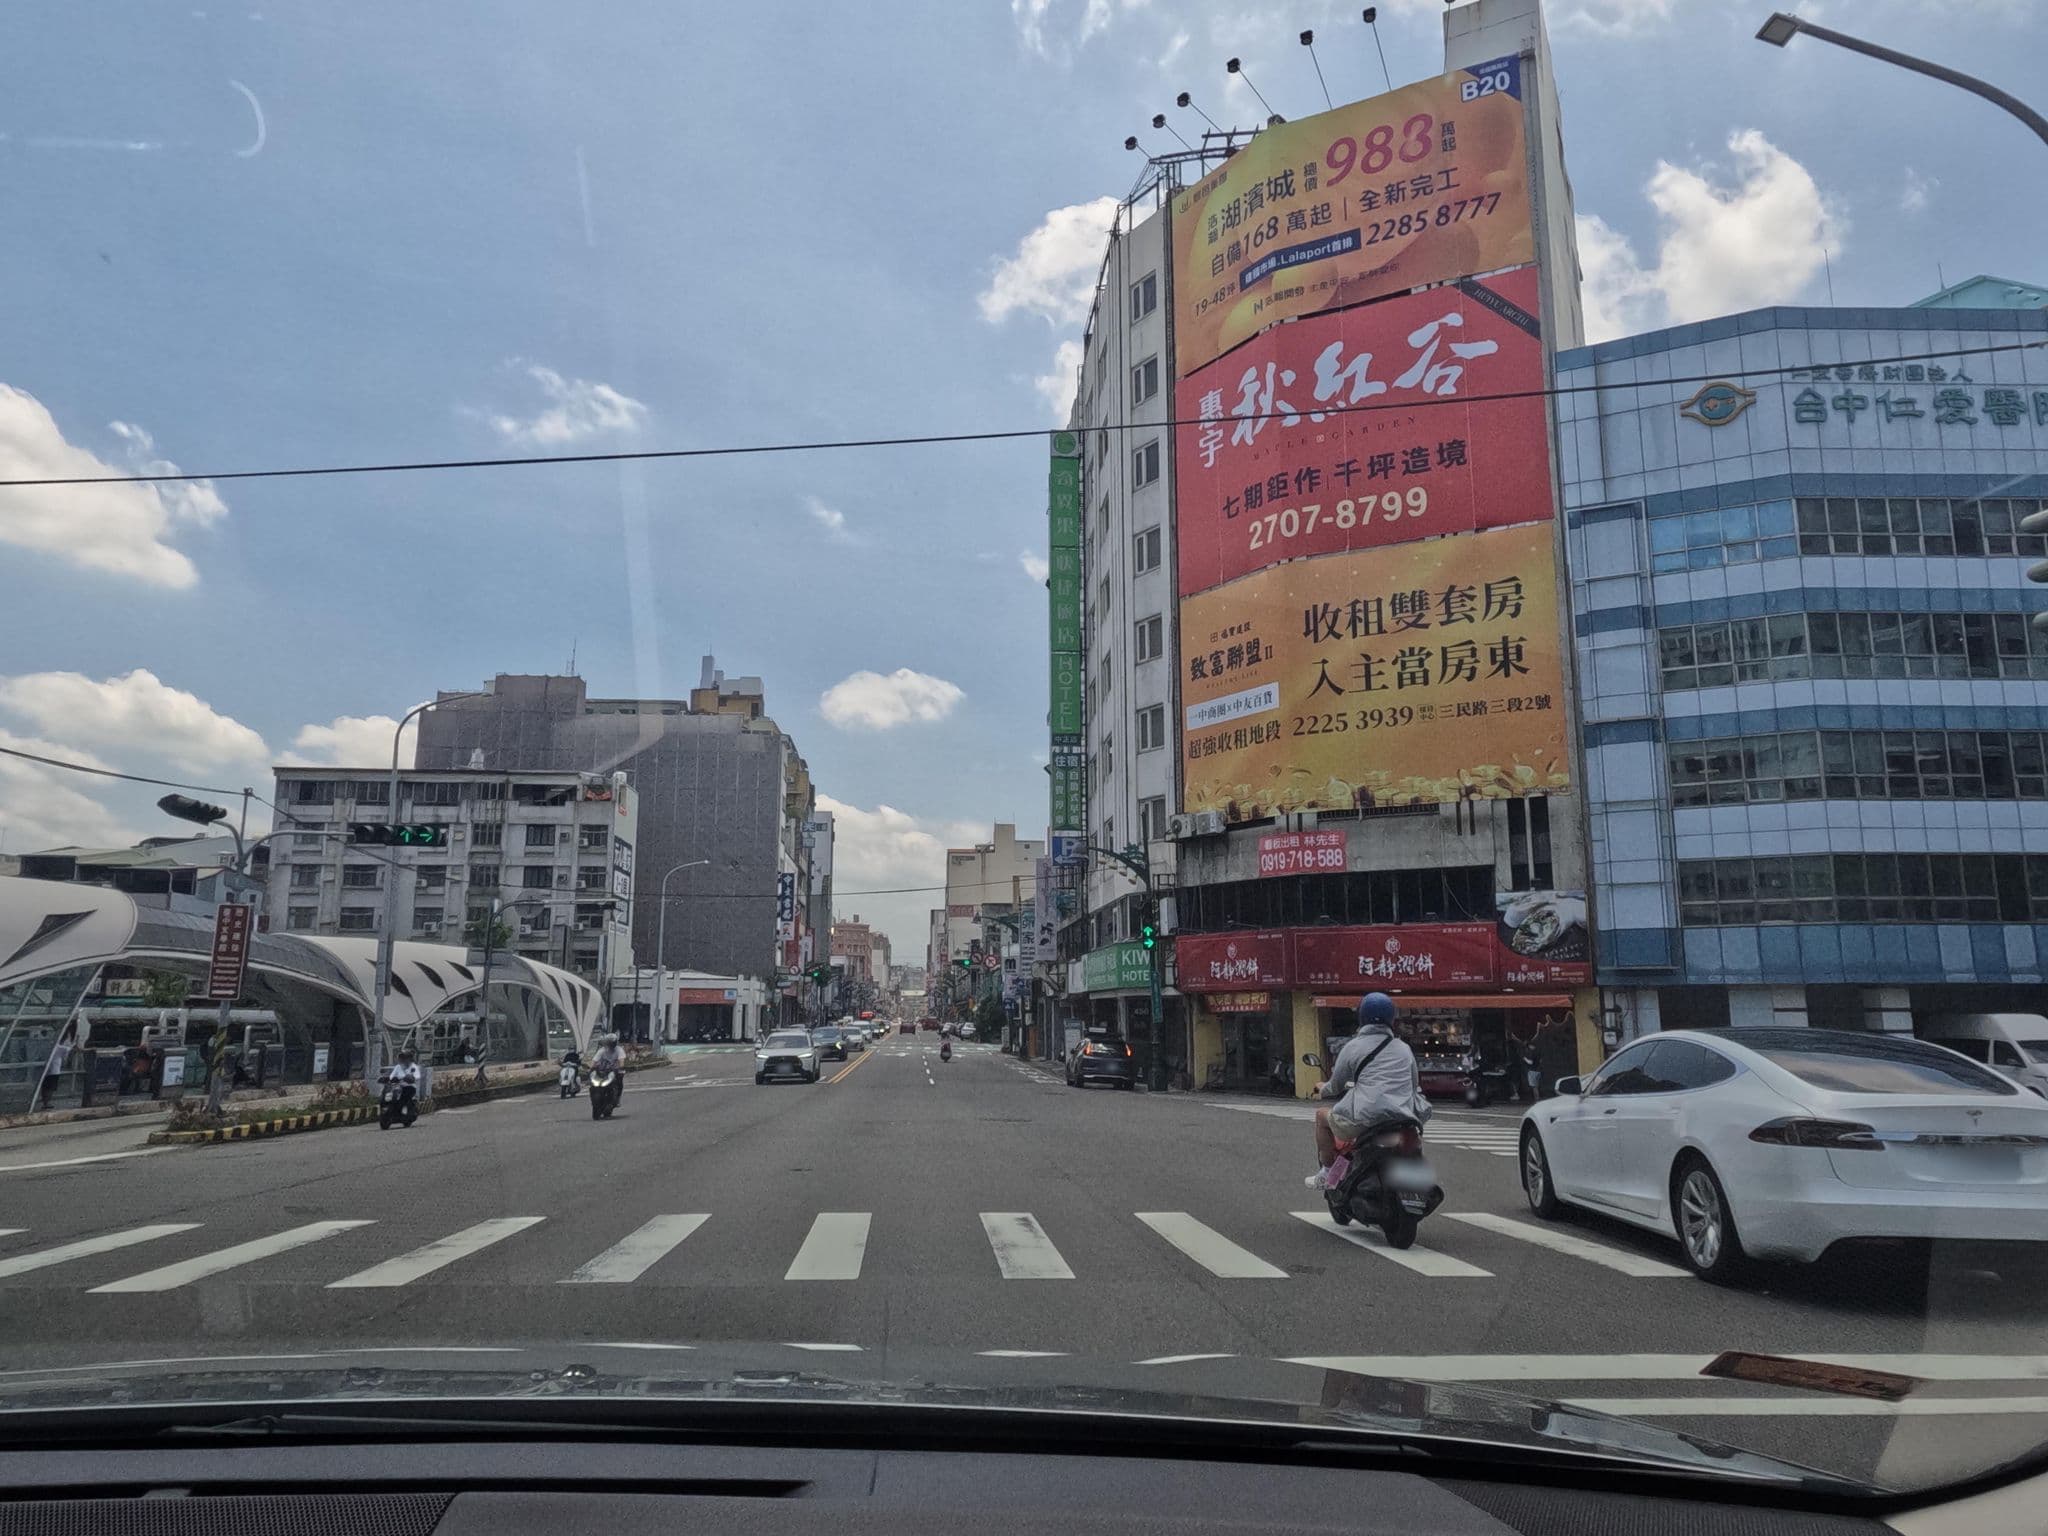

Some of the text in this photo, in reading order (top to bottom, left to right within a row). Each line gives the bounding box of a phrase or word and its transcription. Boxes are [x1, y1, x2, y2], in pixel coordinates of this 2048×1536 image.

[1461, 71, 1511, 102] B20
[1221, 168, 1296, 237] 湖濱城
[1325, 112, 1433, 188] 983
[1359, 166, 1461, 213] 全新完工
[1365, 209, 1429, 246] 2285
[1435, 191, 1502, 227] 8777
[1198, 387, 1224, 469] 惠宇
[1222, 437, 1468, 520] 七期鉅作 千坪造境
[1249, 486, 1428, 551] 2707-8799
[1303, 575, 1526, 644] 收租雙套房
[1305, 635, 1531, 700] 入主當房東
[1059, 656, 1074, 731] HOTEL
[1292, 694, 1552, 737] 2225 3939 三民路三段2號
[1055, 755, 1079, 768] 住宿
[1188, 719, 1281, 760] 超強收租地段
[1261, 848, 1344, 872] 0919-718-588
[1304, 834, 1340, 847] 林先生
[1121, 949, 1151, 966] KIW
[1121, 969, 1151, 981] HOTE
